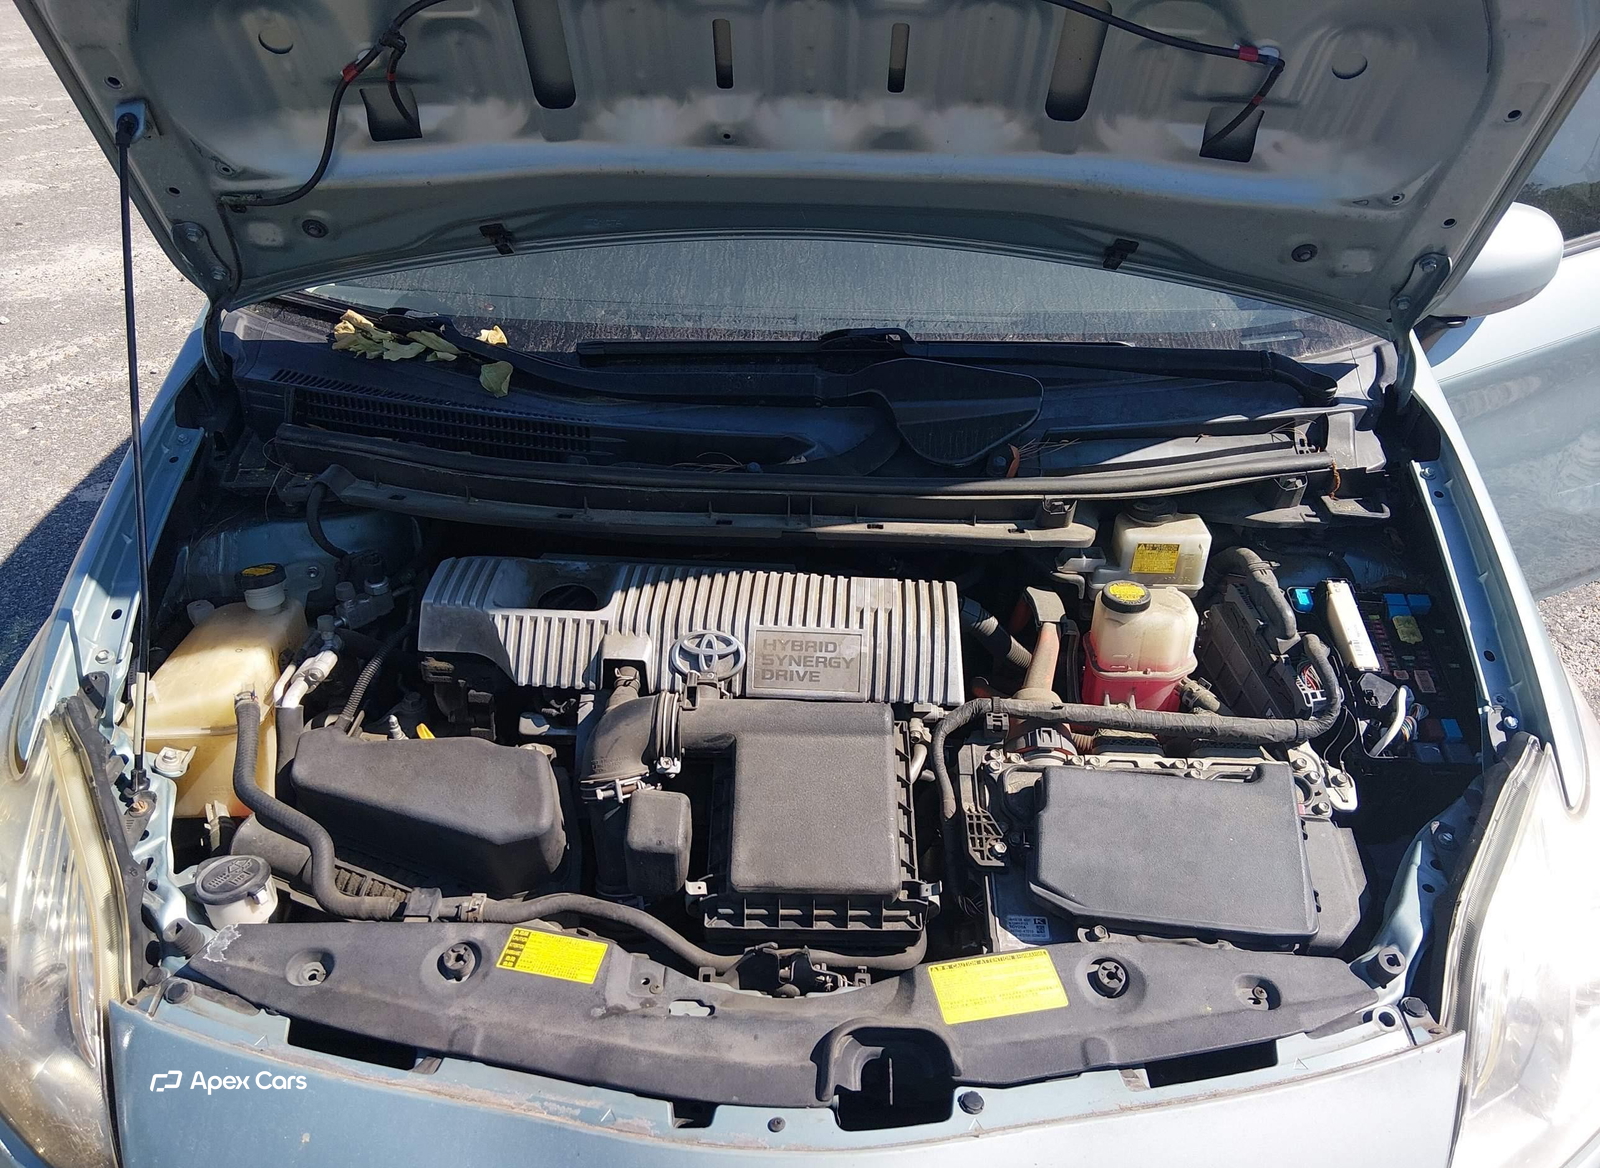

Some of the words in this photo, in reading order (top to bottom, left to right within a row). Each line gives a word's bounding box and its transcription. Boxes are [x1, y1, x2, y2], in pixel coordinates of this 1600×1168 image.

[762, 639, 838, 654] HYBRID
[761, 654, 855, 669] SYNERGY
[761, 668, 821, 683] DRIVE
